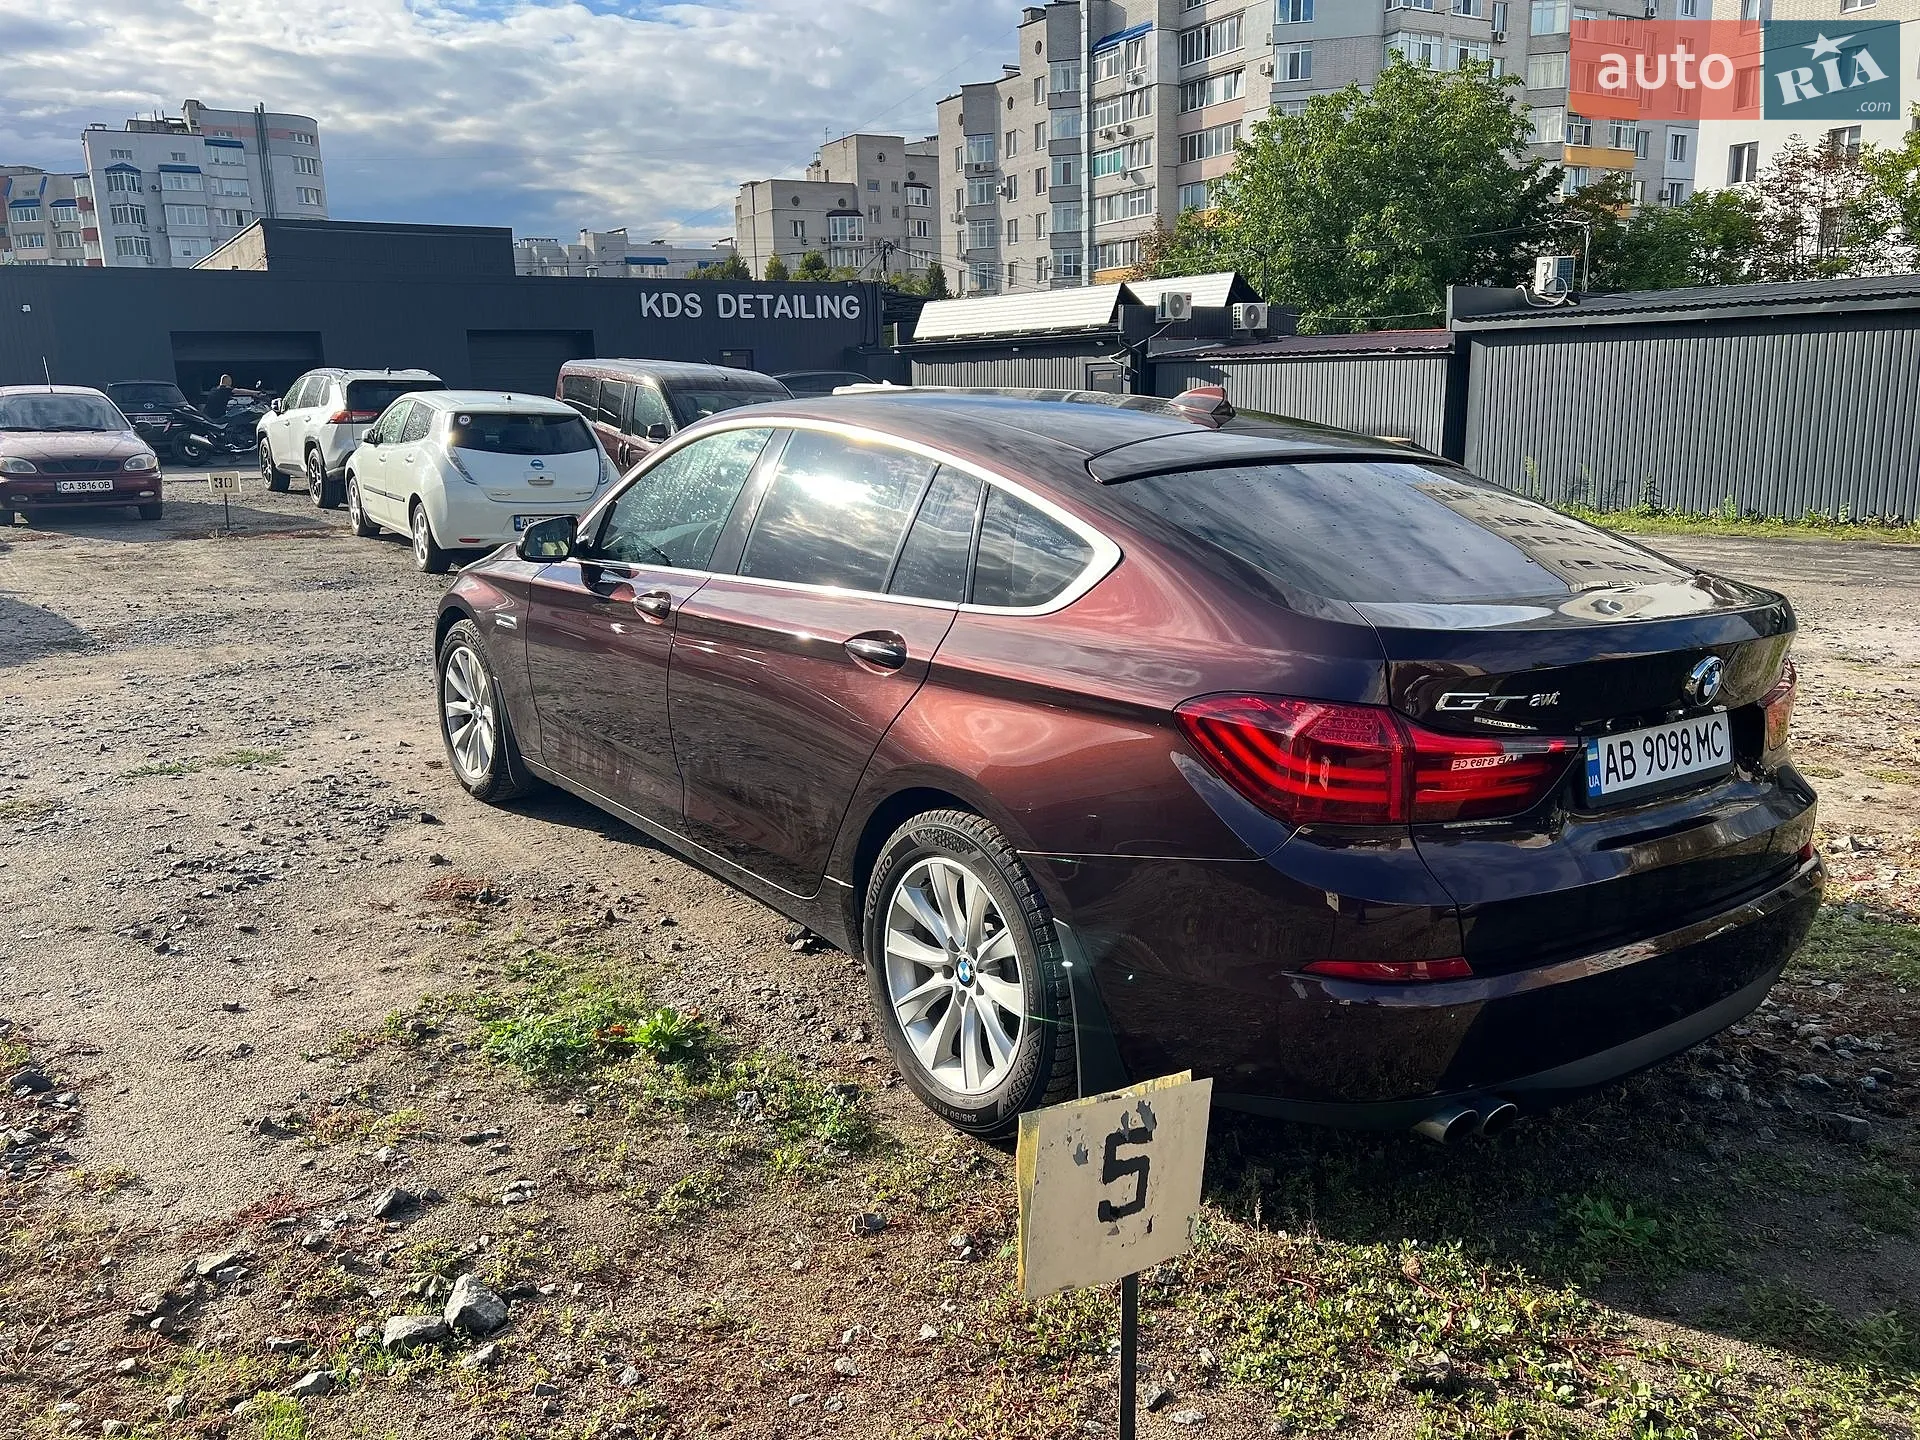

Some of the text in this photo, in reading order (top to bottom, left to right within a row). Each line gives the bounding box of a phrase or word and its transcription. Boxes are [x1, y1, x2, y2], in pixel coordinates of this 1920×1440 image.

[639, 292, 861, 319] KDS DETAILING
[62, 481, 111, 490] CA 3816 OB
[1435, 692, 1528, 711] GT
[1606, 720, 1724, 785] AB 9098 MC
[1588, 774, 1600, 788] UA
[867, 855, 892, 919] KUMHO
[949, 1109, 977, 1122] 245/50
[1098, 1126, 1153, 1223] 5
